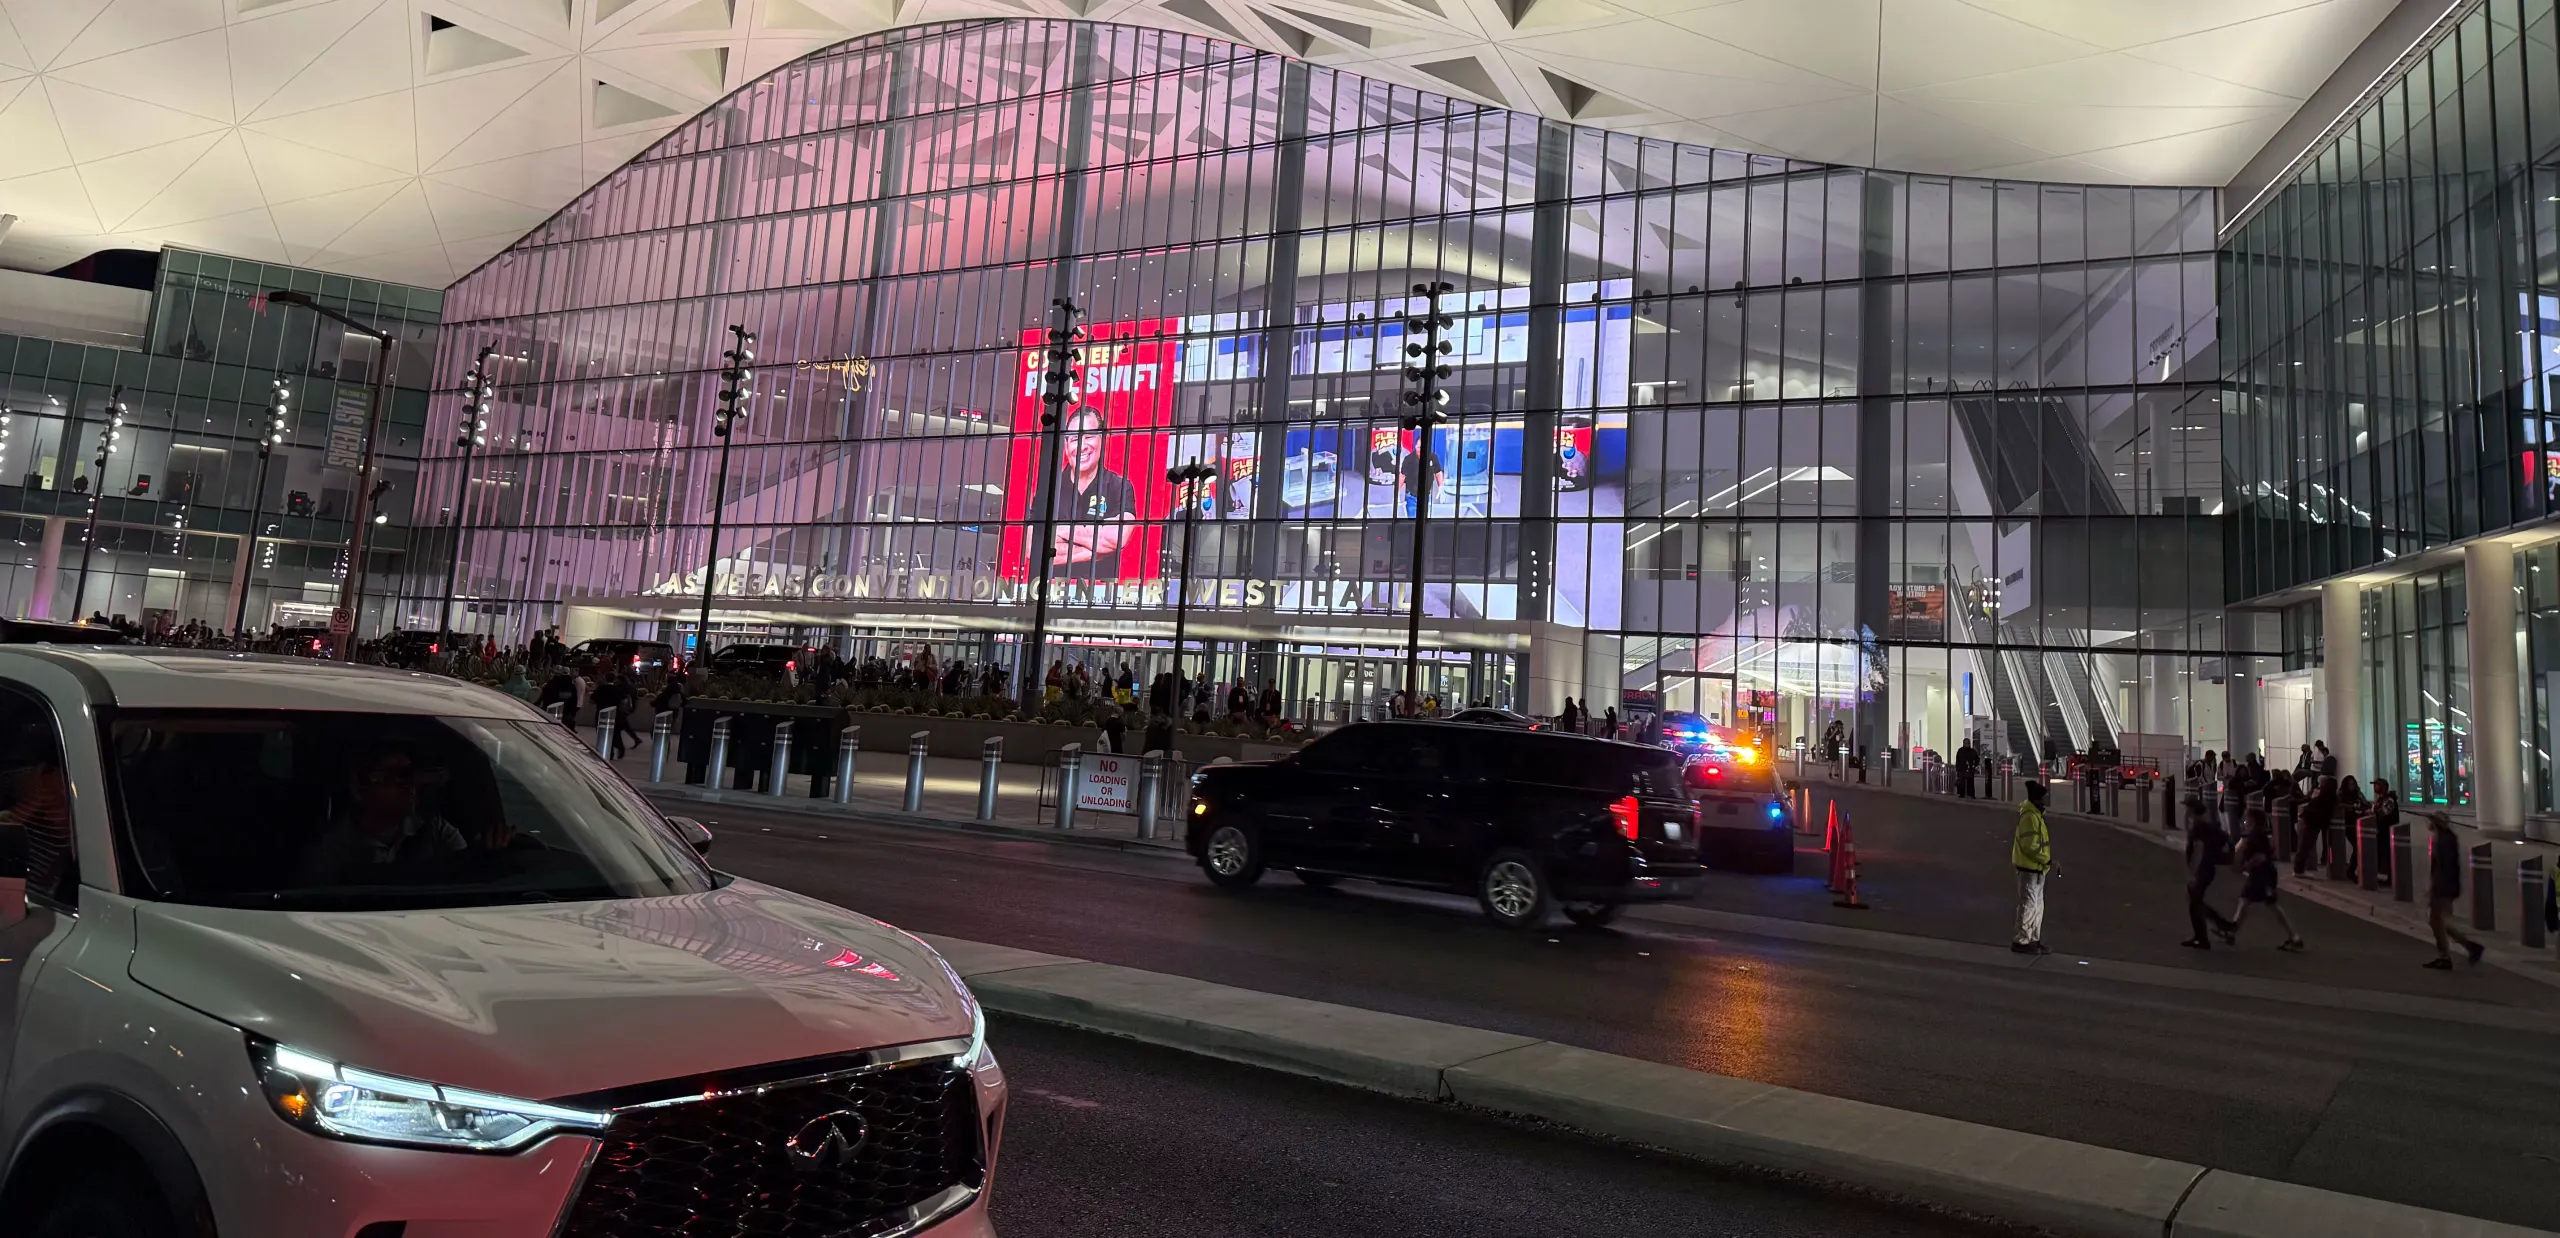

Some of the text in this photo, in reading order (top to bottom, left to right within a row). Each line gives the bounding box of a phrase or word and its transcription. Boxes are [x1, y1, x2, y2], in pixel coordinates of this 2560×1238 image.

[1025, 363, 1162, 397] PL SWIFT
[327, 397, 367, 468] LAS VEGAS
[1233, 459, 1259, 472] FLE
[1233, 466, 1259, 481] TAP
[653, 572, 699, 595] LAS
[711, 573, 803, 597] VEGAS
[813, 572, 1015, 600] CONVENTION
[1029, 575, 1165, 605] CENTER
[1186, 578, 1290, 607] WEST
[1310, 580, 1412, 610] HALL
[1099, 759, 1118, 773] NO
[1089, 774, 1127, 786] LOADING
[1101, 786, 1113, 795] OR
[1081, 795, 1131, 809] UNLOADING
